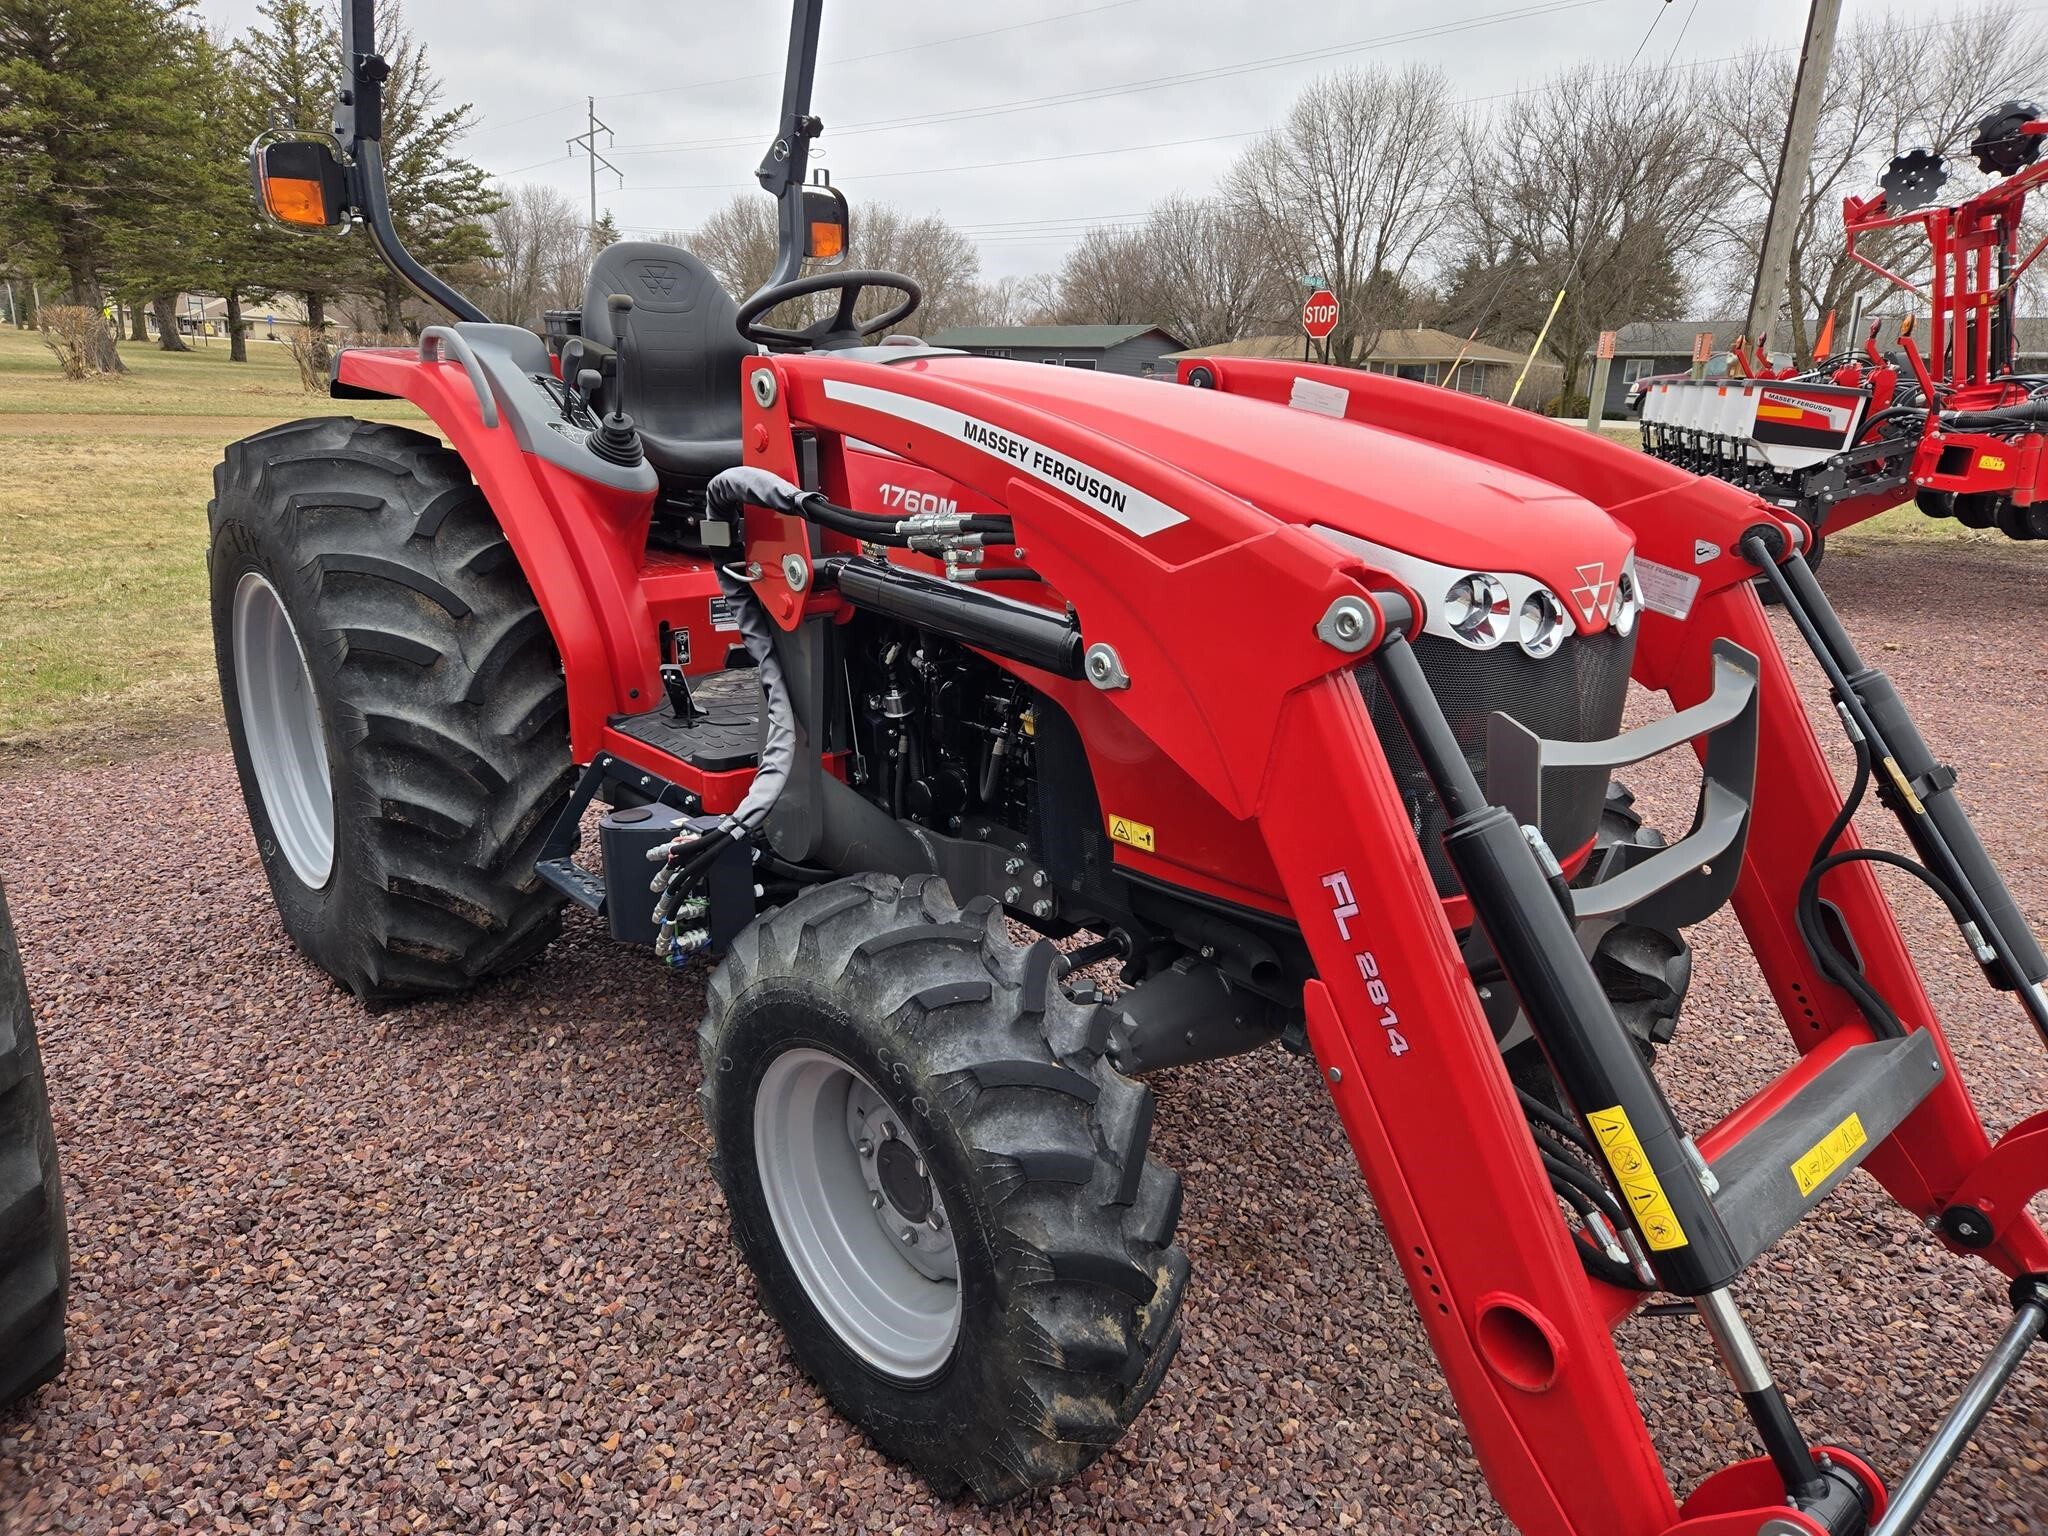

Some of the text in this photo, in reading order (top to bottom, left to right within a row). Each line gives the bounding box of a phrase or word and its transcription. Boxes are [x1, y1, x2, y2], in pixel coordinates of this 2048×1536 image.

[1305, 305, 1337, 324] STOP
[1767, 393, 1833, 413] MASSEY FERGUSON
[963, 421, 1127, 513] MASSEY FERGUSON
[879, 483, 958, 514] 1760M
[1321, 871, 1409, 1057] FL 2814
